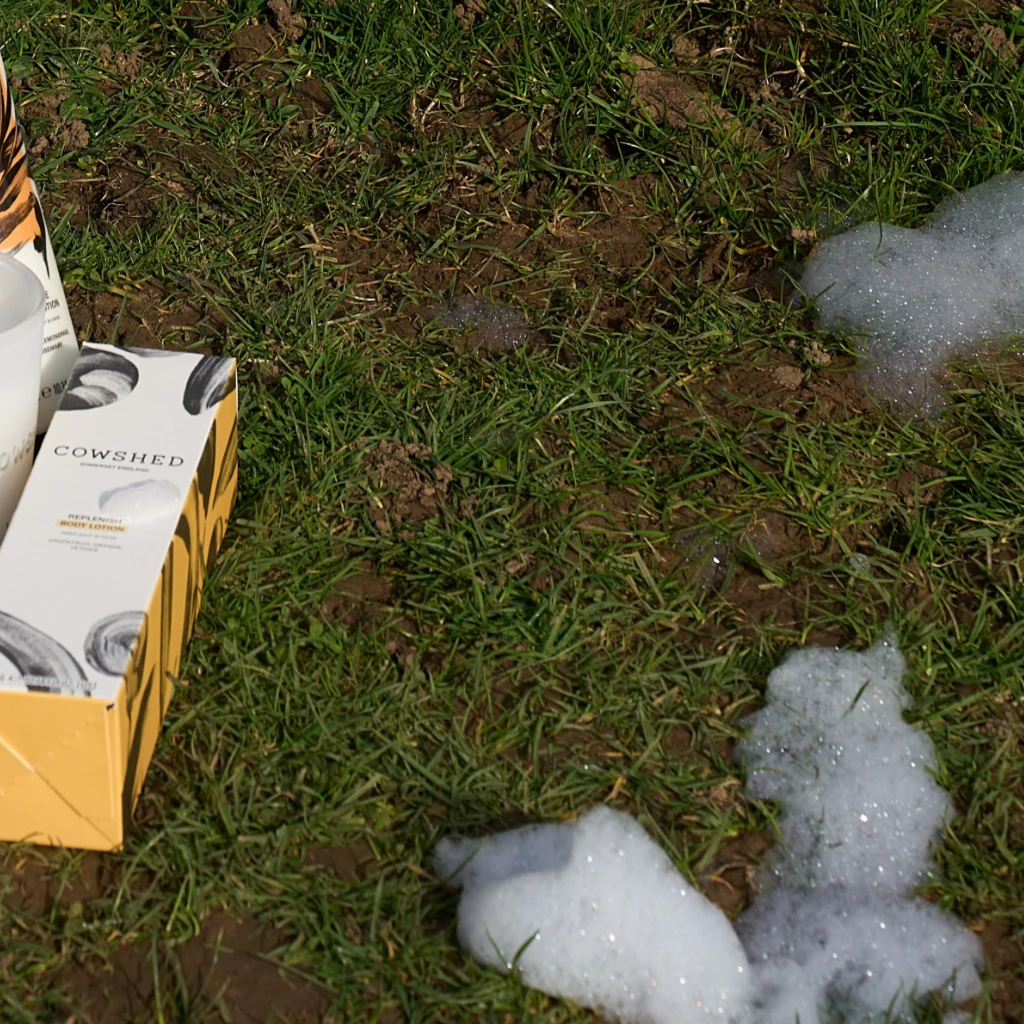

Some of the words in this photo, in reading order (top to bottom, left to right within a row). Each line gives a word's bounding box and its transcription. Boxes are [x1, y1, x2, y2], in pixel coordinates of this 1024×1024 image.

[53, 445, 184, 467] COWSHED
[80, 461, 116, 470] SOMERSET
[117, 464, 150, 473] ENGLAND
[68, 513, 123, 524] REPLENISH
[59, 520, 87, 528] BODY
[88, 522, 125, 533] LOTION
